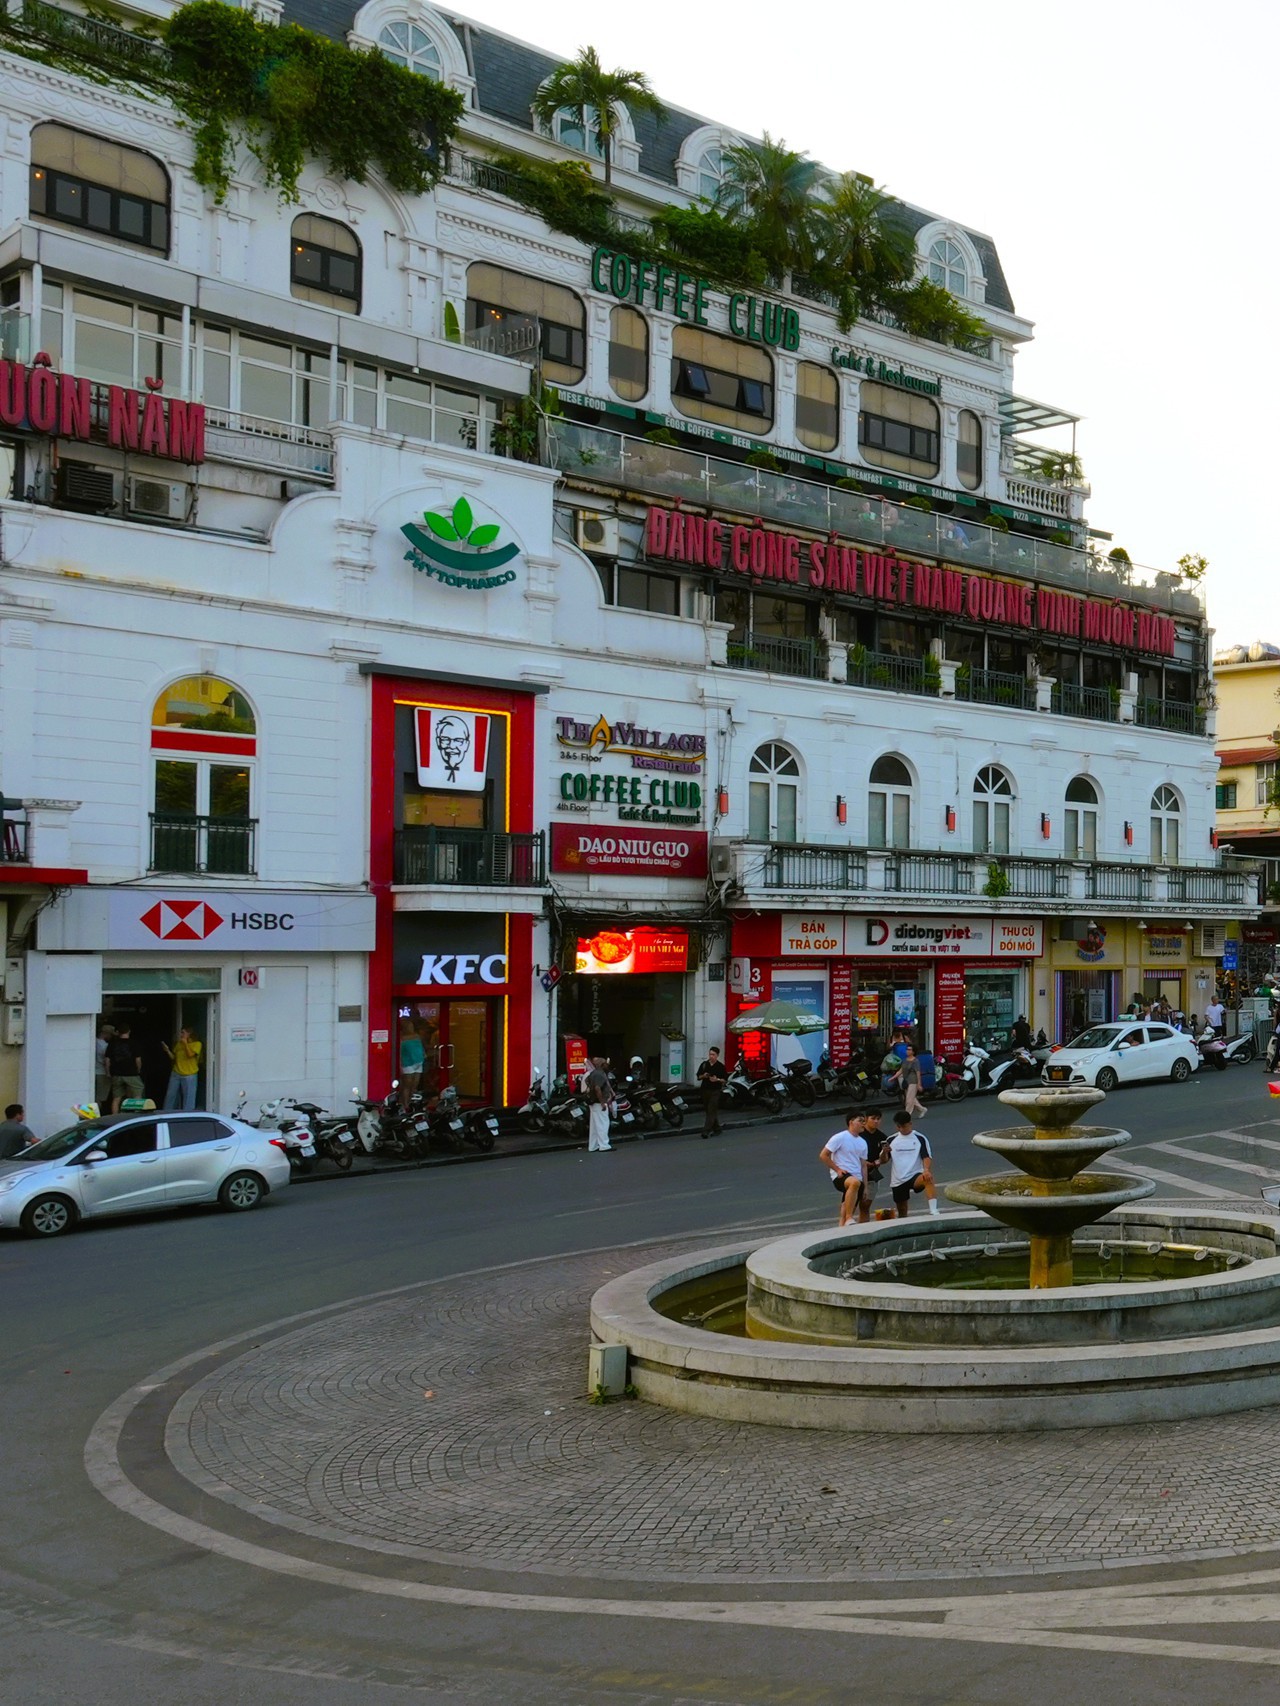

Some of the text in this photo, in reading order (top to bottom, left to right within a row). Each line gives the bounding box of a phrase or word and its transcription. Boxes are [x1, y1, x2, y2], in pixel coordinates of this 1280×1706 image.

[591, 247, 800, 352] COFFEE CLUB
[879, 361, 942, 397] Restaurant
[585, 396, 606, 412] FOOD
[108, 376, 206, 465] NĂM
[665, 416, 686, 432] EGGS
[687, 421, 715, 440] COFFEE
[732, 436, 751, 450] BEER
[768, 446, 806, 464] COCKTAILS
[846, 468, 883, 485] BREAKFAST
[897, 480, 917, 494] STEAK
[931, 487, 957, 503] SALMON
[1013, 510, 1029, 523] PIZZA
[1041, 516, 1058, 529] PASTA
[403, 550, 517, 590] PHYTOPHARCO
[646, 496, 1175, 658] ĐẢNG CỘNG SẢN VIỆT NAM QUANG VINH MUÔN NĂM
[581, 751, 602, 763] Floor
[631, 755, 701, 774] Restaurants
[560, 772, 701, 809] COFFEE CLUB
[556, 802, 589, 812] 4th Floor
[578, 836, 689, 858] DAO NIU GUO
[231, 912, 295, 931] HSBC
[801, 920, 826, 934] BÁN
[1001, 924, 1035, 937] THU CŨ
[814, 936, 838, 950] GÓP
[1017, 938, 1035, 951] MỚI
[415, 954, 508, 986] KFC
[751, 968, 761, 983] 3
[833, 1007, 850, 1016] Apple
